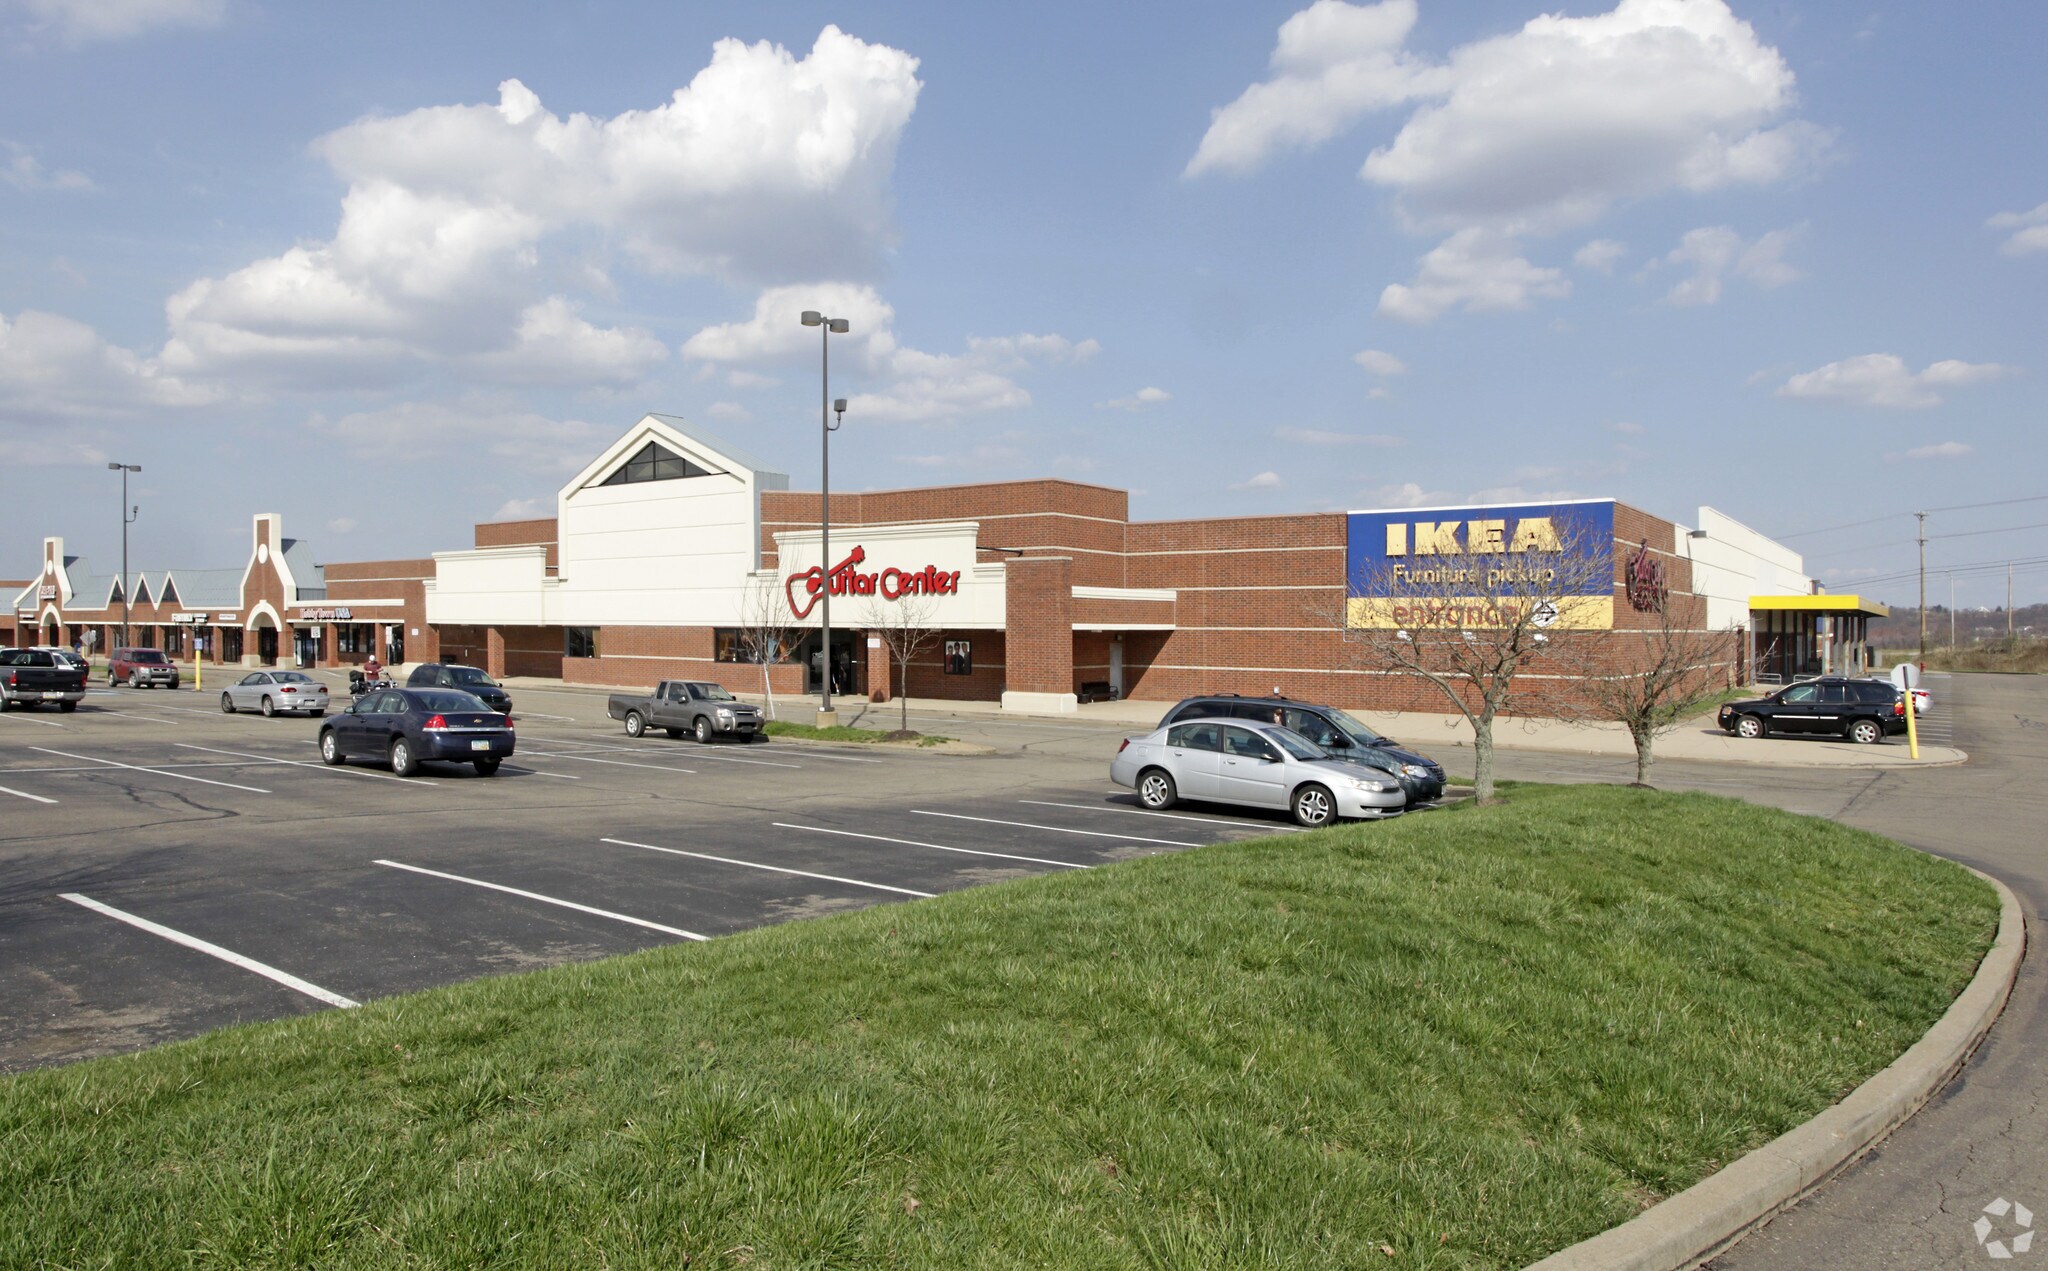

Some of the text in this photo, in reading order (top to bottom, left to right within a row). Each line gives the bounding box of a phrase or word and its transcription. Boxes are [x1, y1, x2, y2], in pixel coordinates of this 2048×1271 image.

[1386, 517, 1563, 556] IKEA
[786, 545, 960, 619] Guitar Center
